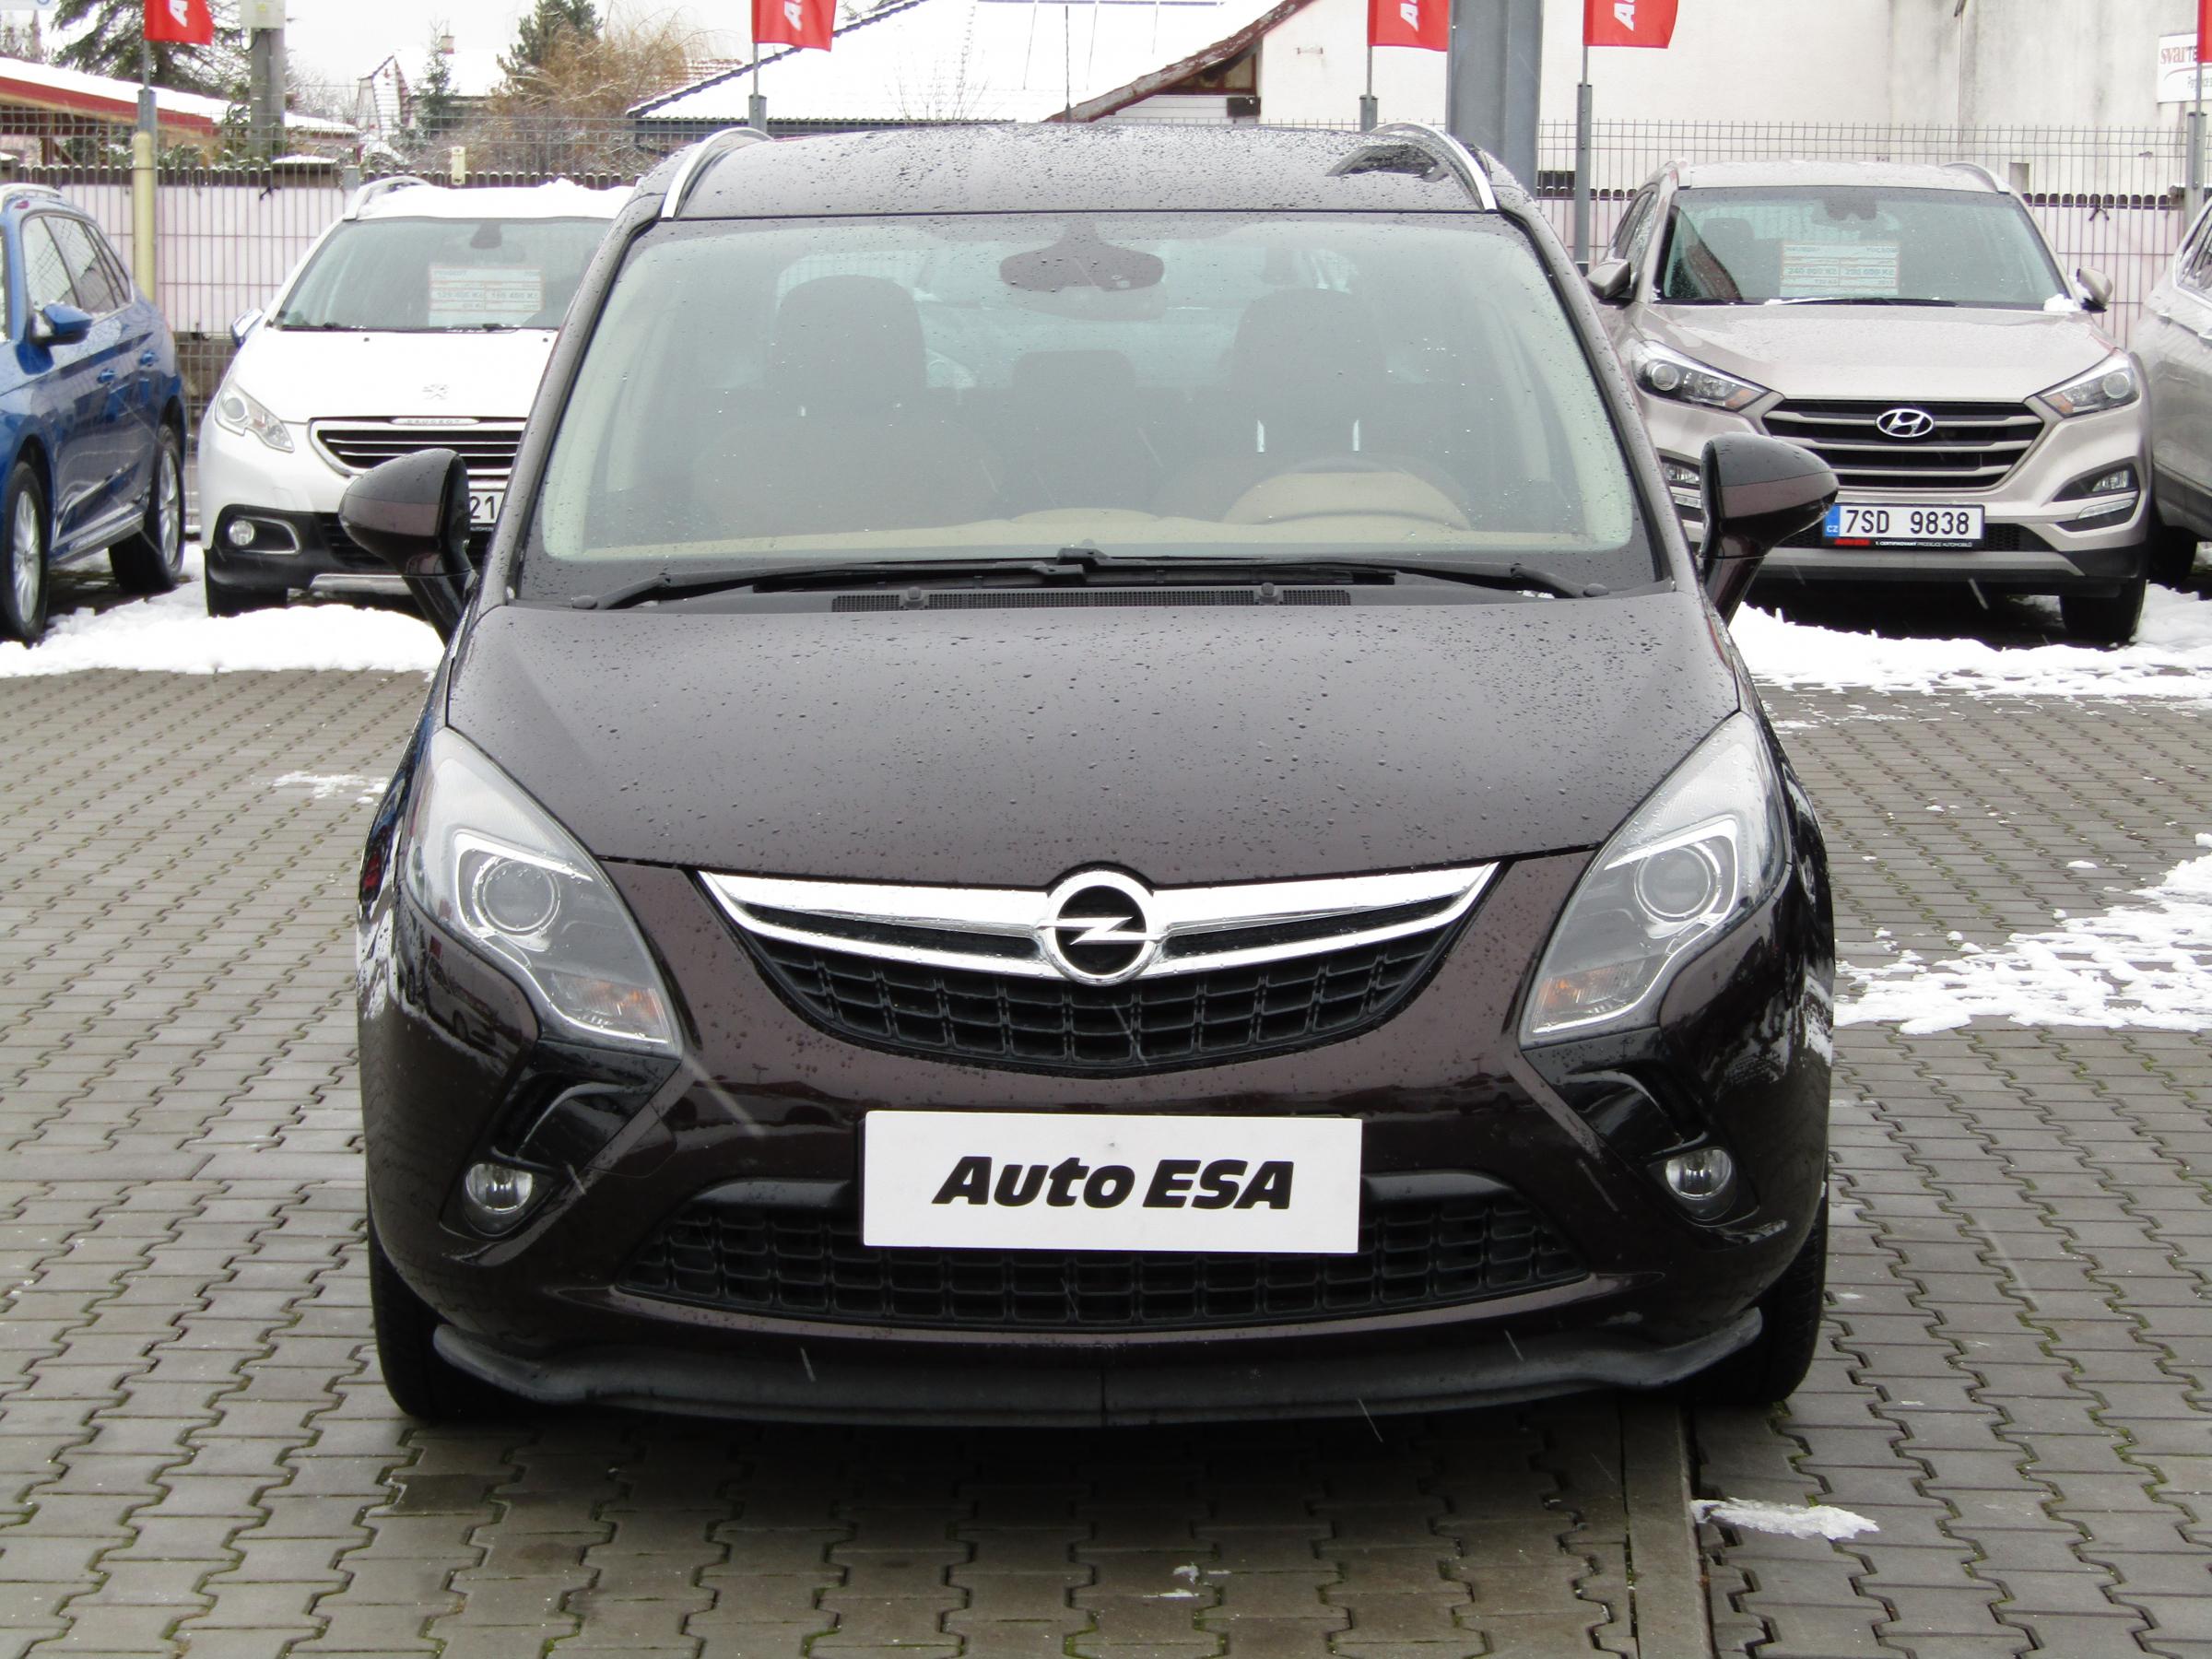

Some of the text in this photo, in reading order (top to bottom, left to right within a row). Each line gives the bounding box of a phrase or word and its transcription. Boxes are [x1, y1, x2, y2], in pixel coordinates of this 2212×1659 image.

[1846, 510, 1970, 535] 7SD 9838
[931, 1156, 1295, 1211] Auto ESA
